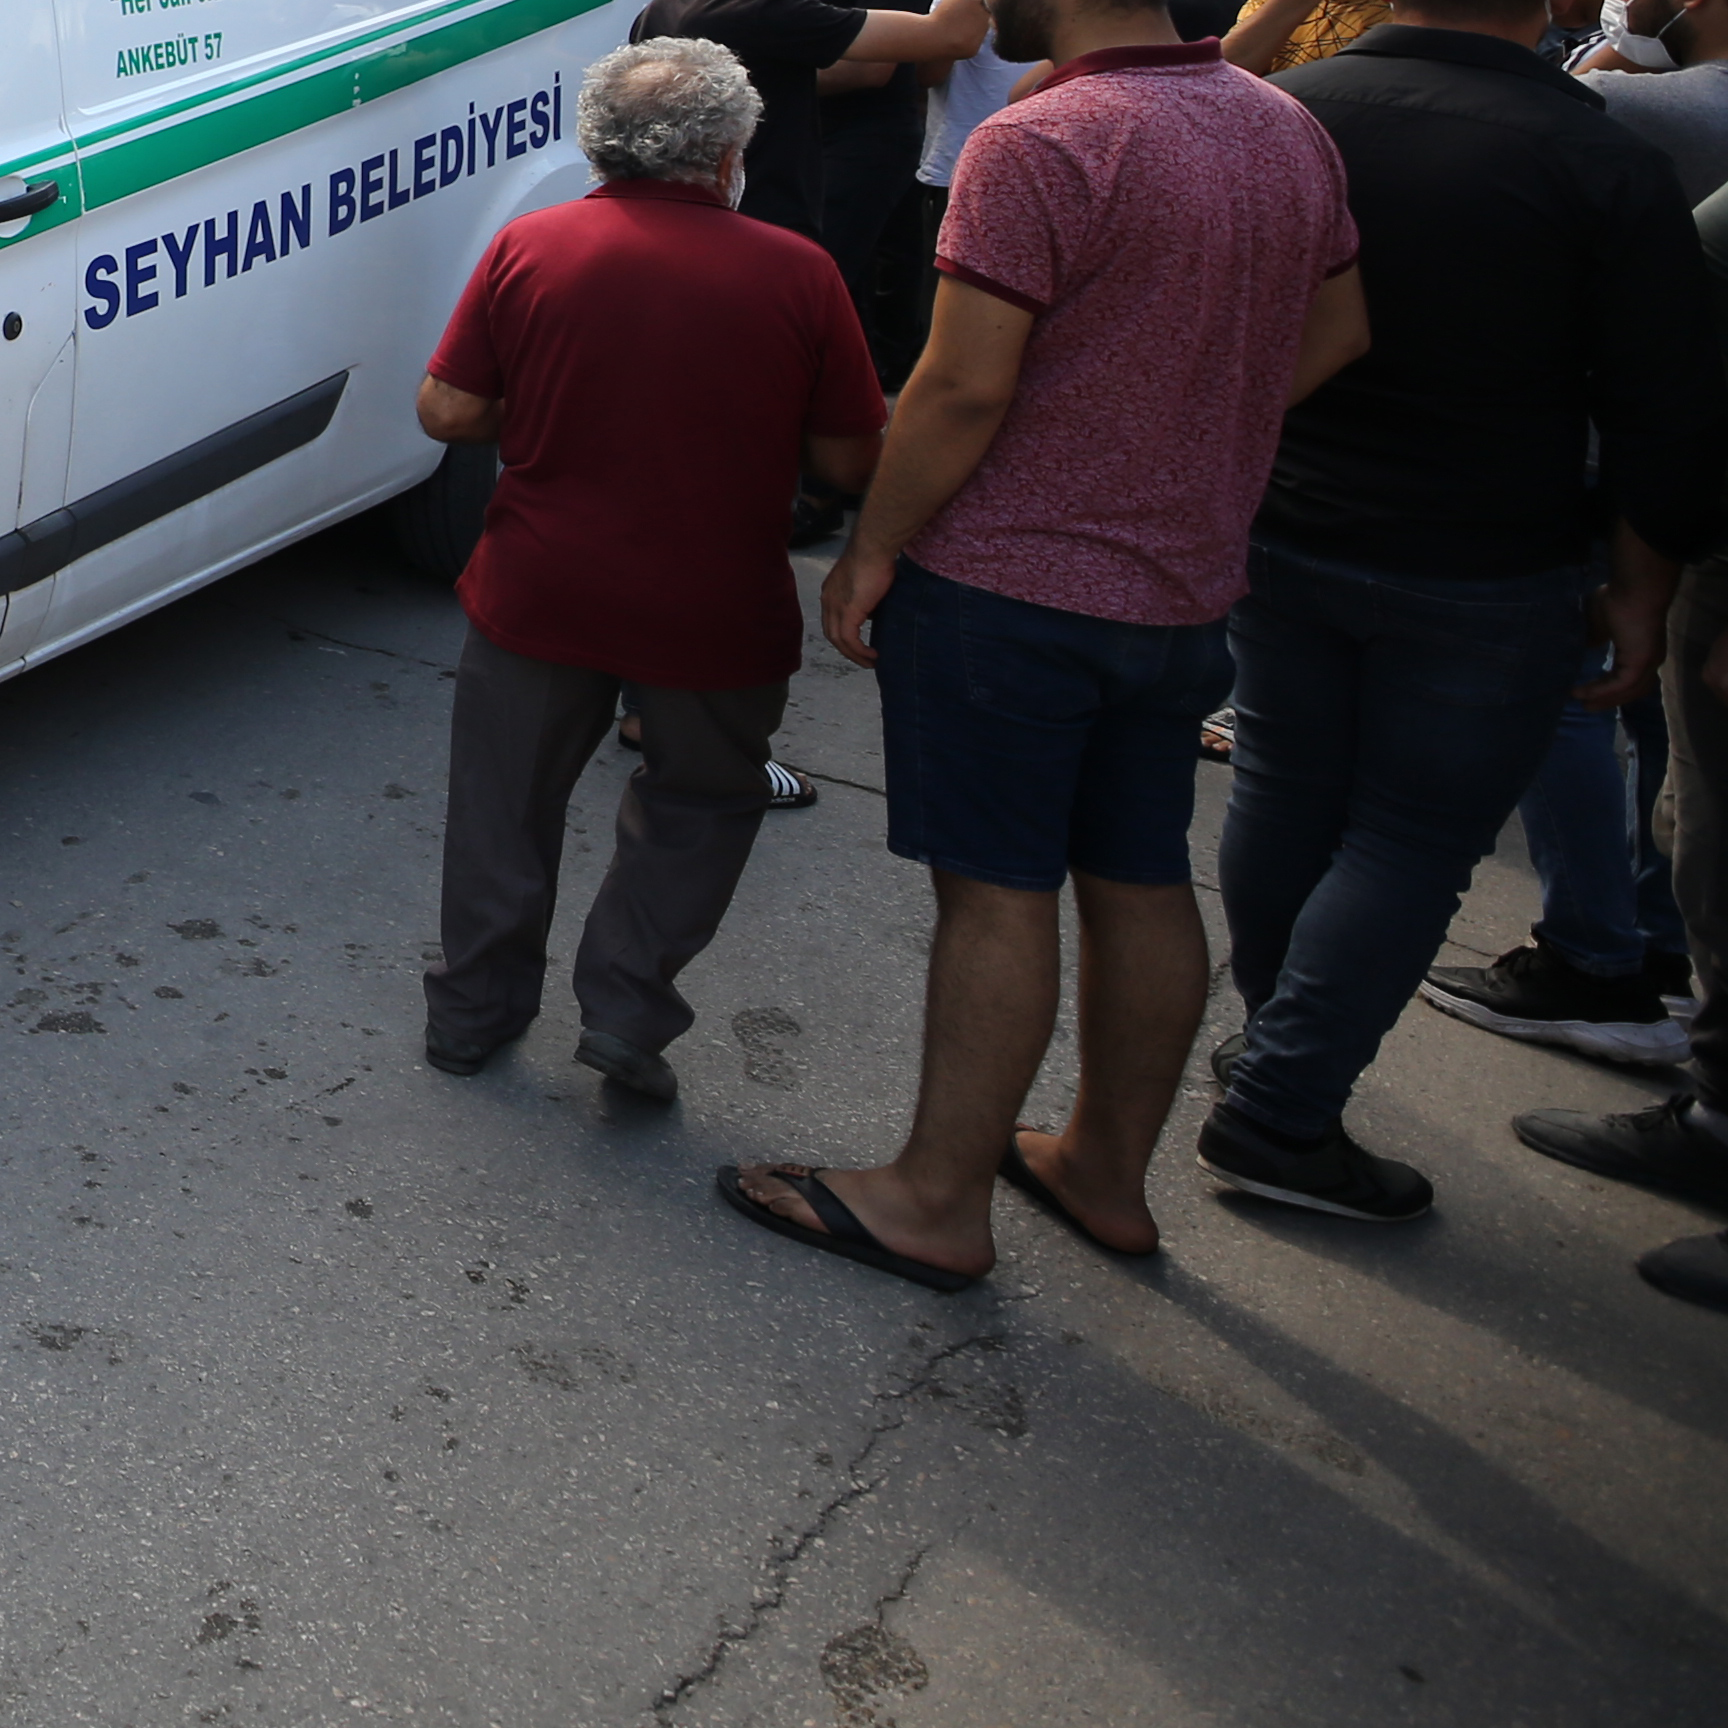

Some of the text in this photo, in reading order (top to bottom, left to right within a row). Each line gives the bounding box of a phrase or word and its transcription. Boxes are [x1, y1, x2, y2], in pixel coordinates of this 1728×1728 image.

[116, 32, 224, 78] ANKEBÜT 57
[84, 72, 563, 332] SEYHAN BELEDİYESİ
